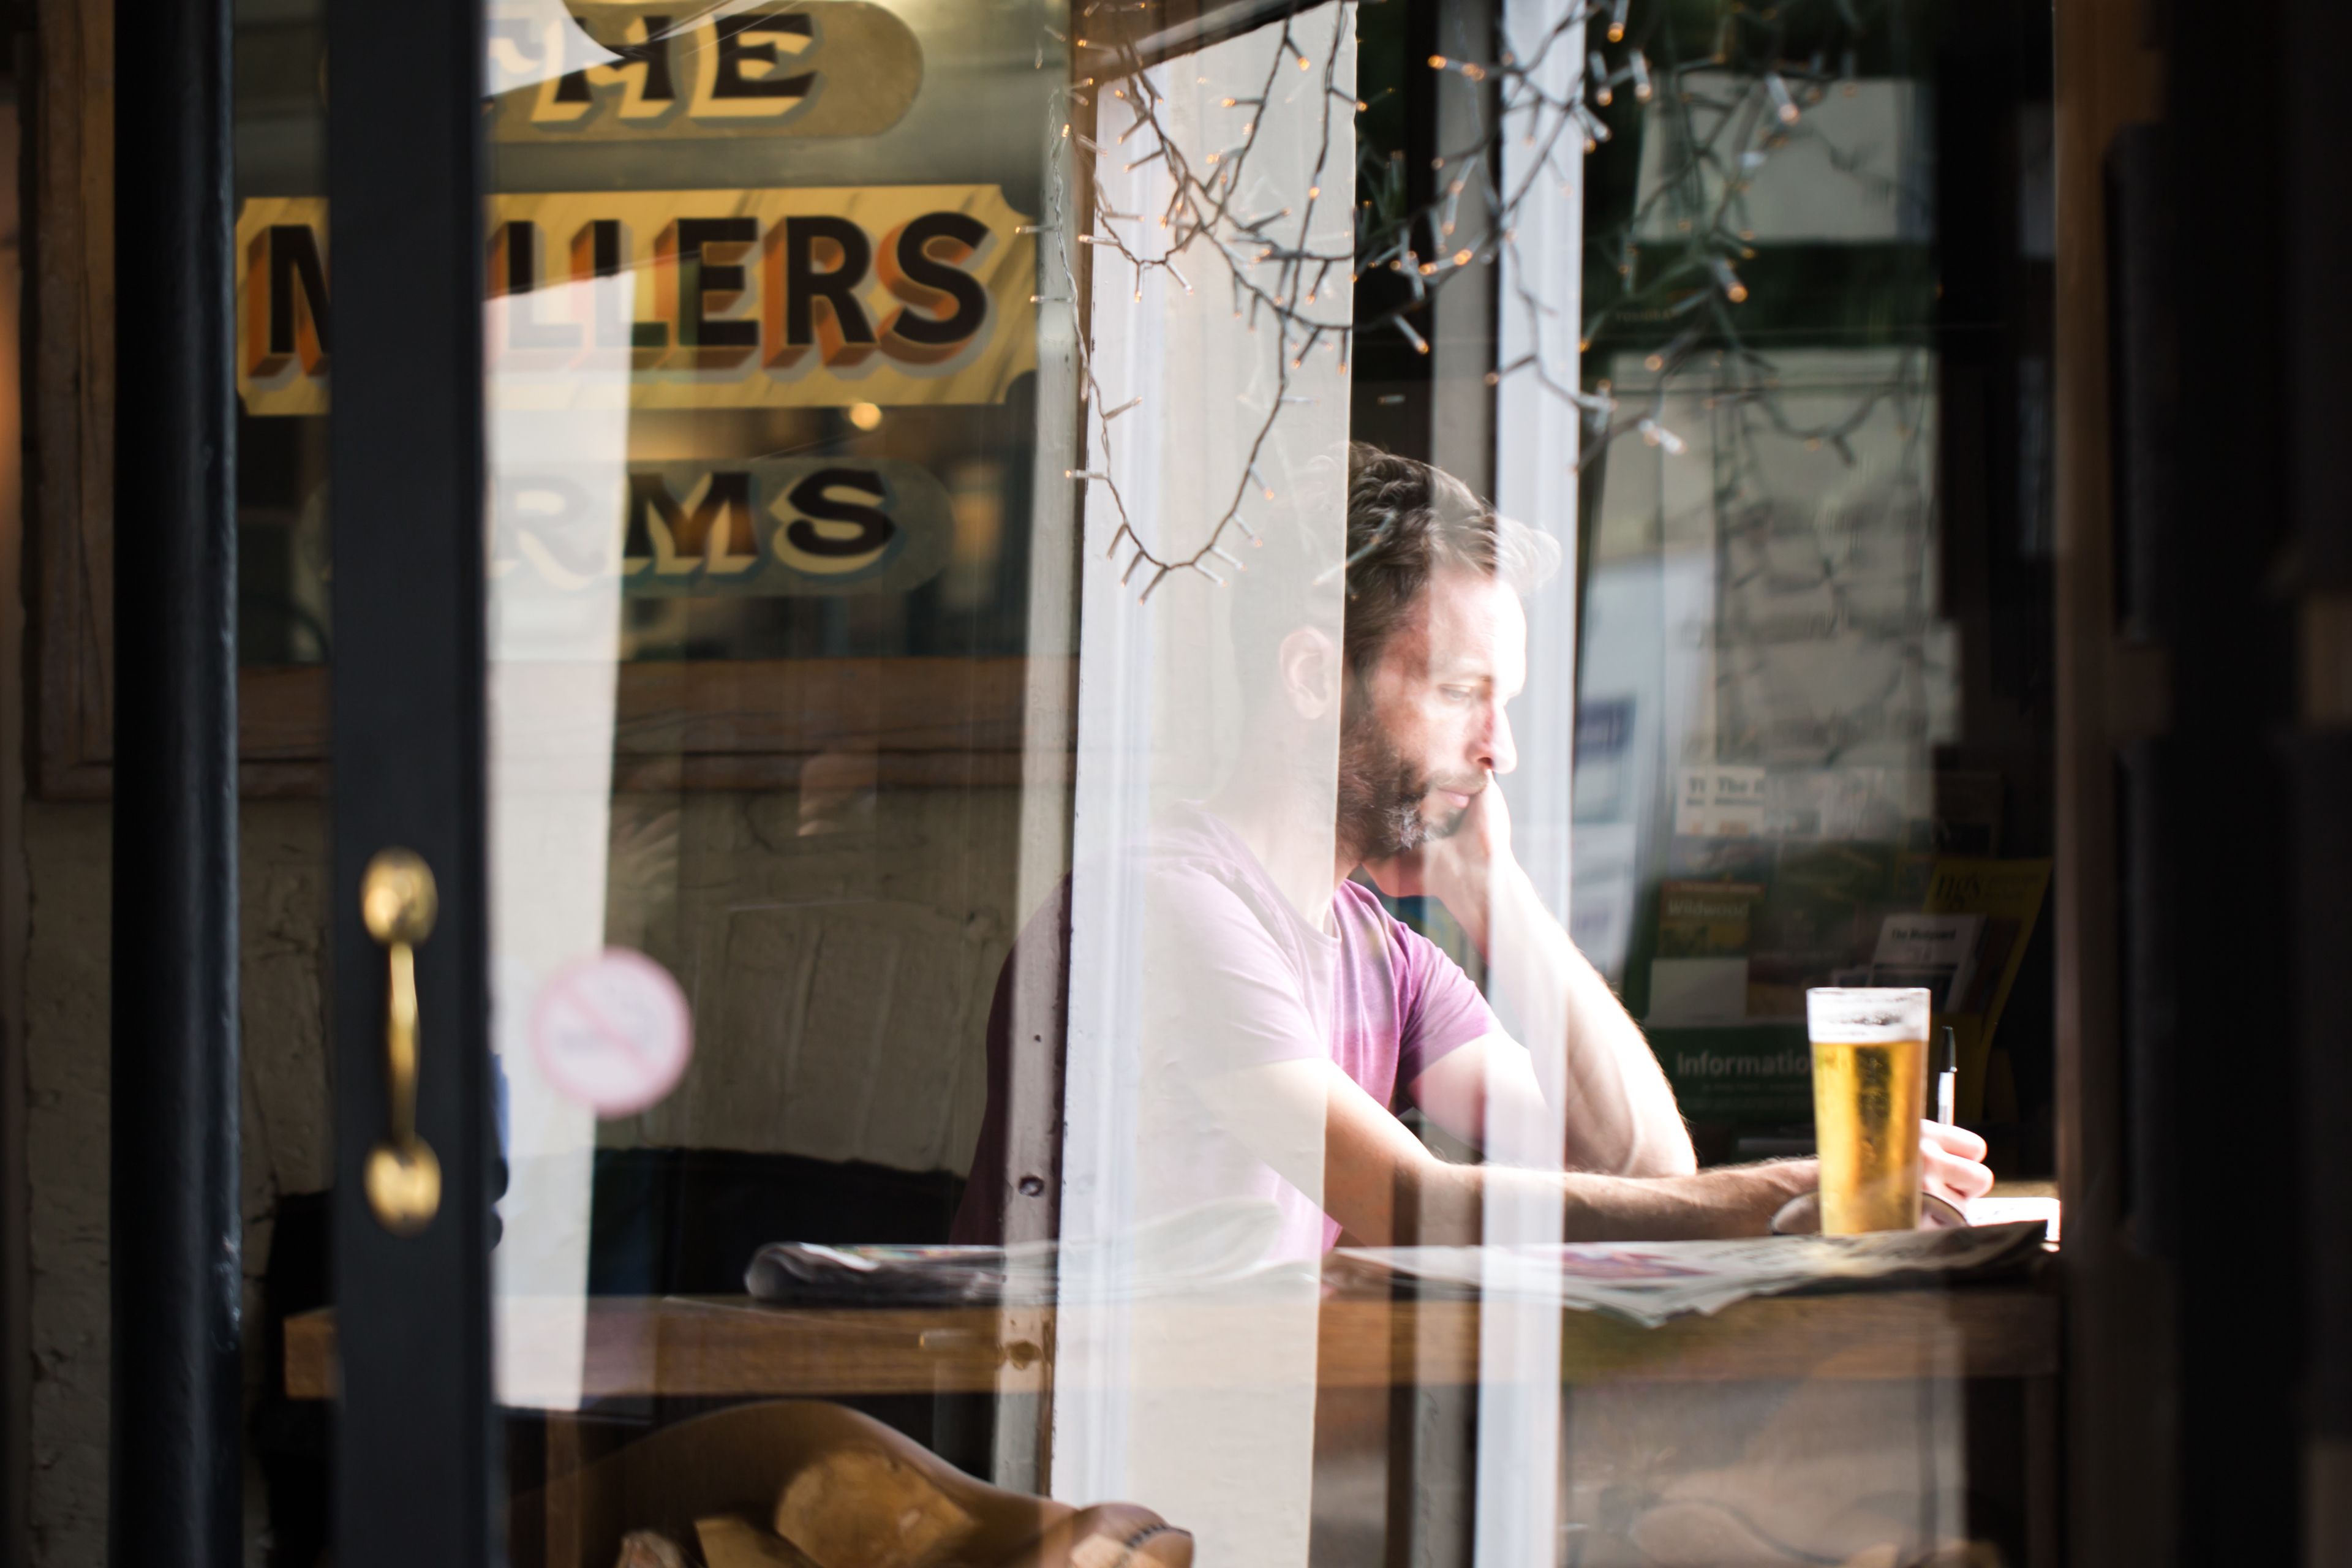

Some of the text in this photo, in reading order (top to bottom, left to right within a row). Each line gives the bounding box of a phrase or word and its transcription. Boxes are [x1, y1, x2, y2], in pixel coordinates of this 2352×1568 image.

[247, 210, 1000, 377] MLLERS
[487, 467, 907, 589] RMS
[1666, 898, 1750, 917] Wildwood
[1676, 1050, 1811, 1076] Informatio
